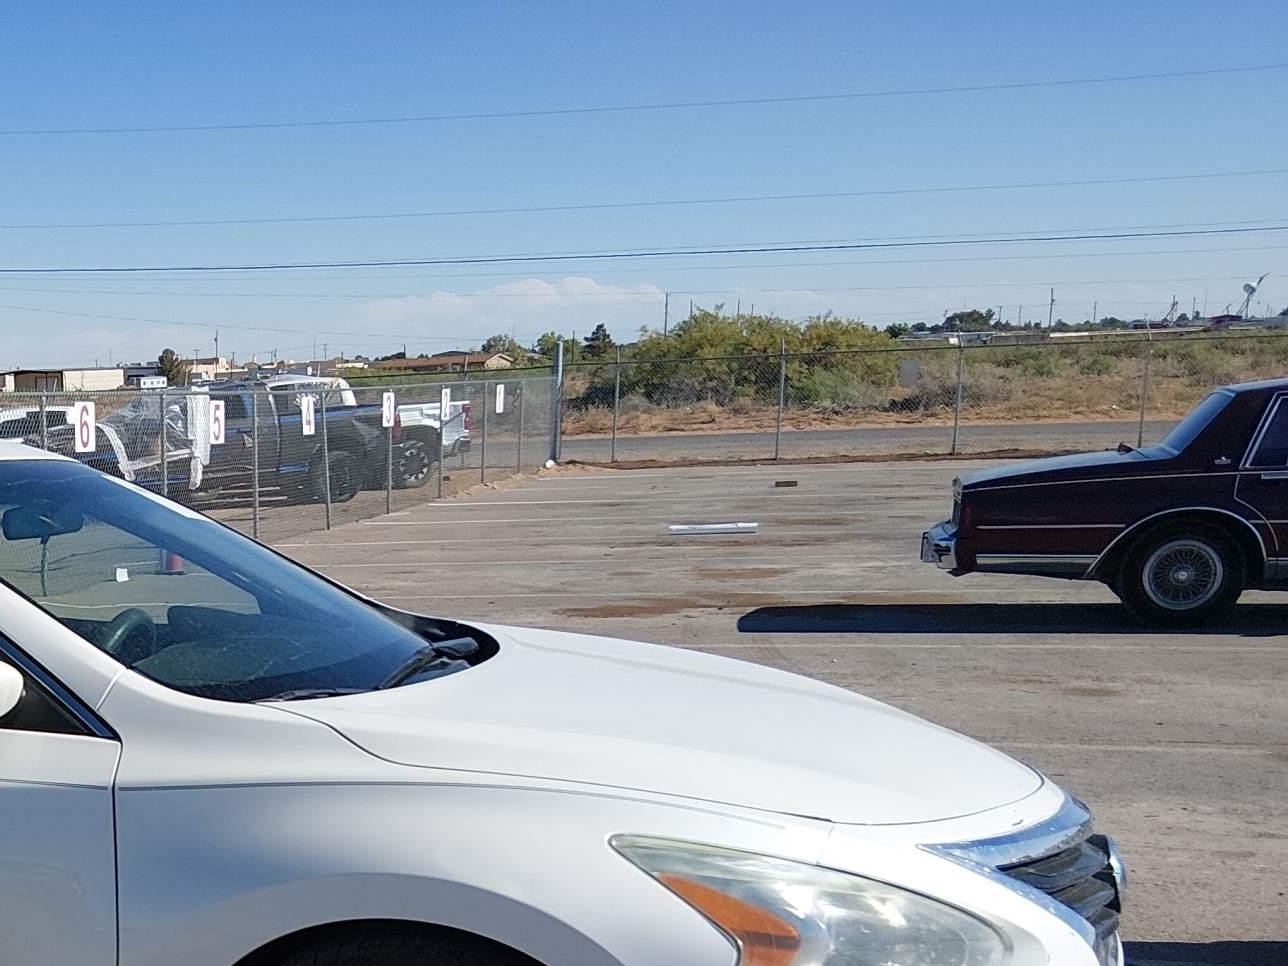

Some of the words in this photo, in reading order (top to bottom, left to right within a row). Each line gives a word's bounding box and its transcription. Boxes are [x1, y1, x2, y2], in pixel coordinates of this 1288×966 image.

[79, 404, 90, 449] 6
[213, 404, 222, 441] 5
[305, 398, 313, 433] 4
[385, 394, 392, 425] 3
